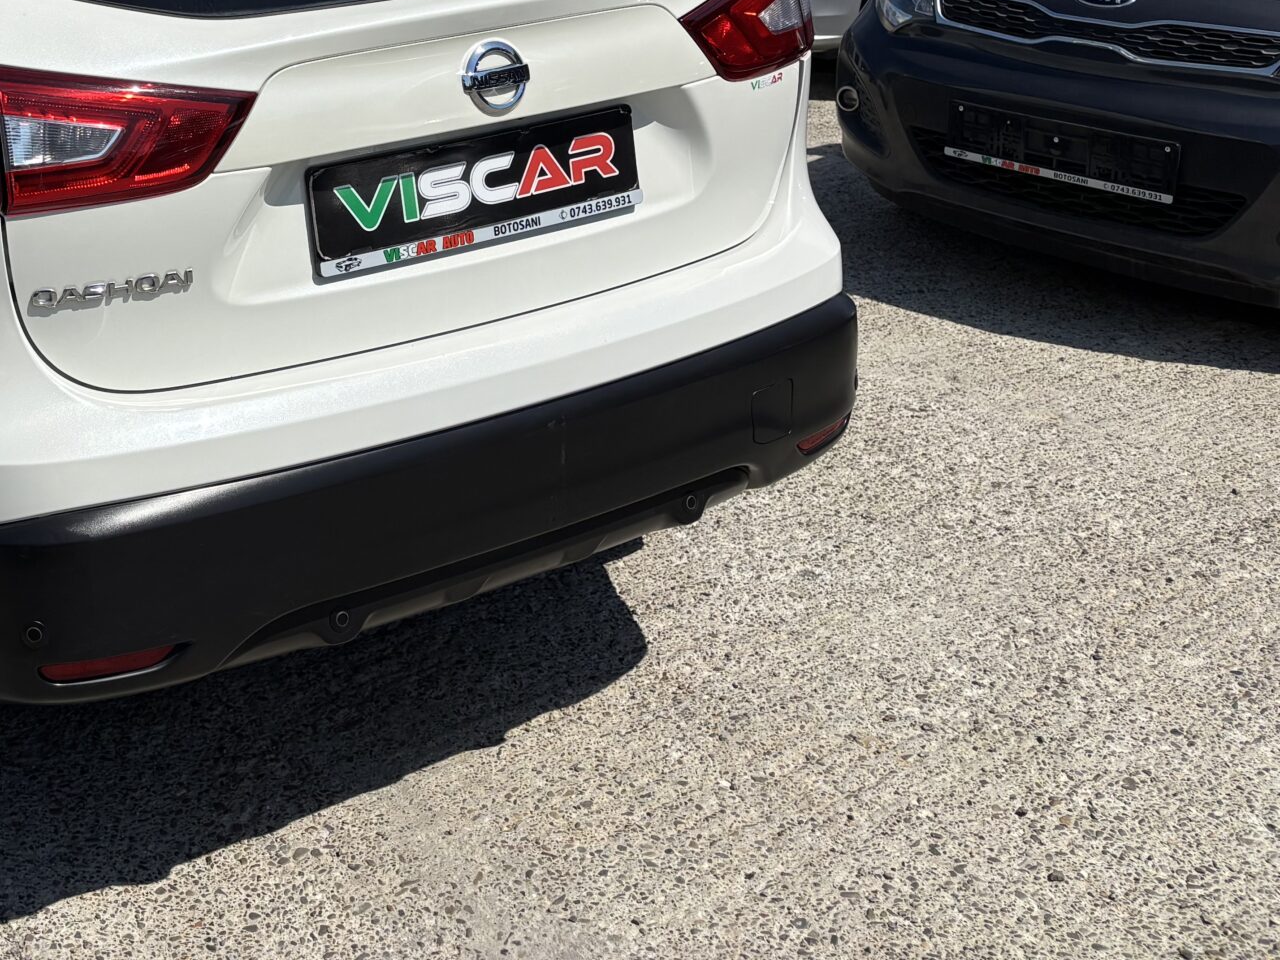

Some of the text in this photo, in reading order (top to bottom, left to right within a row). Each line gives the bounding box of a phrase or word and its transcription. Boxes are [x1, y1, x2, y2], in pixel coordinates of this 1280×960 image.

[333, 131, 620, 232] VISCAR
[1053, 172, 1089, 186] BOTOSANI
[1110, 184, 1163, 201] 0743.639.931
[383, 194, 633, 263] VISCAR AUTO BOTOSANI 0743.639.931
[30, 267, 194, 308] QASHQAI
